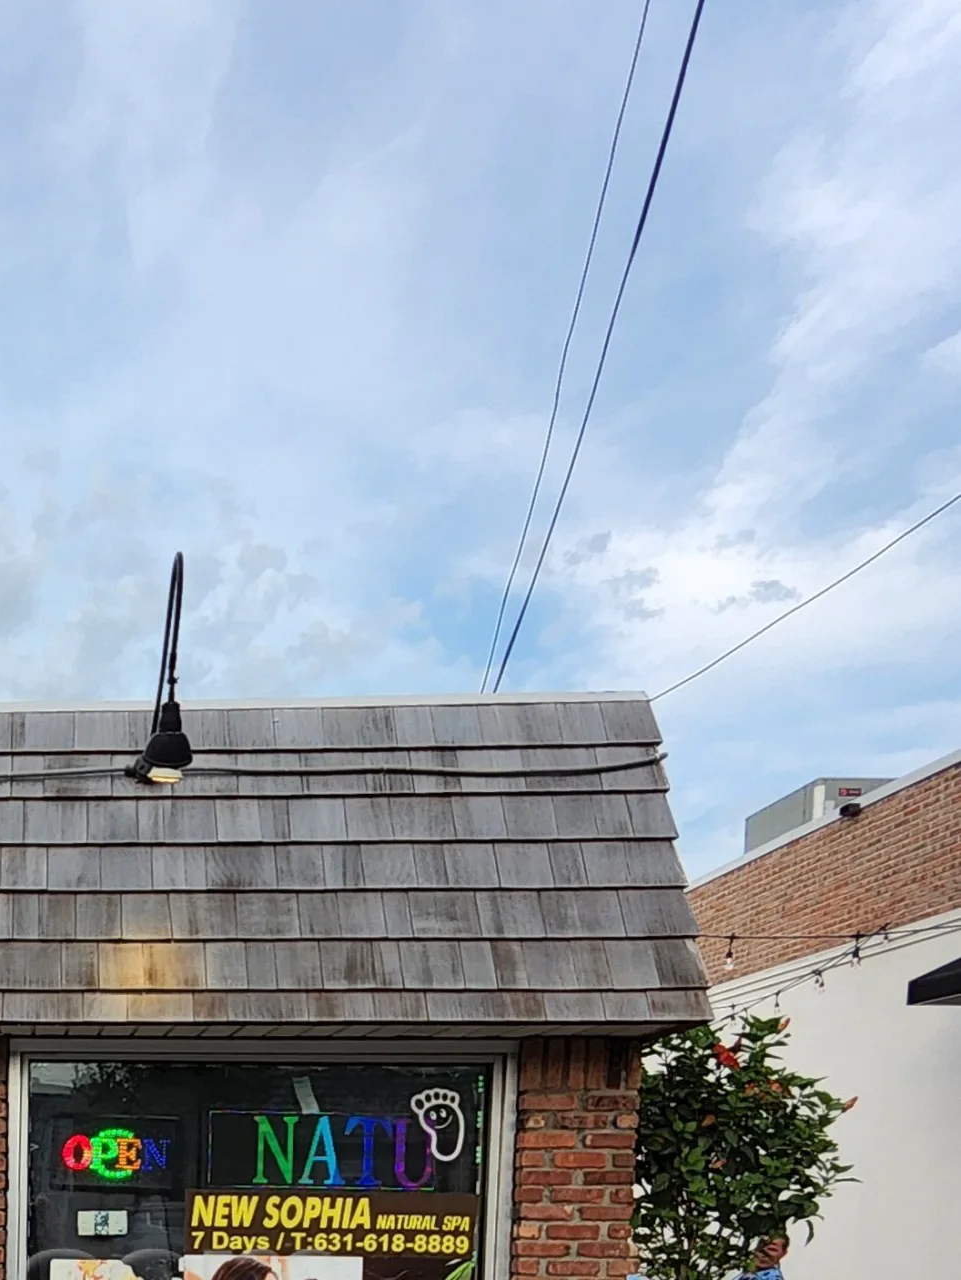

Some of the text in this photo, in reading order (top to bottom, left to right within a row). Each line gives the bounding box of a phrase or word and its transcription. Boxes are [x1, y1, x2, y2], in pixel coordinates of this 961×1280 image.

[61, 1132, 171, 1173] OPEN
[191, 1195, 470, 1232] NEW SOPHIA NATURAL SPA
[191, 1232, 470, 1255] 7 Days / T:631-618-8889
